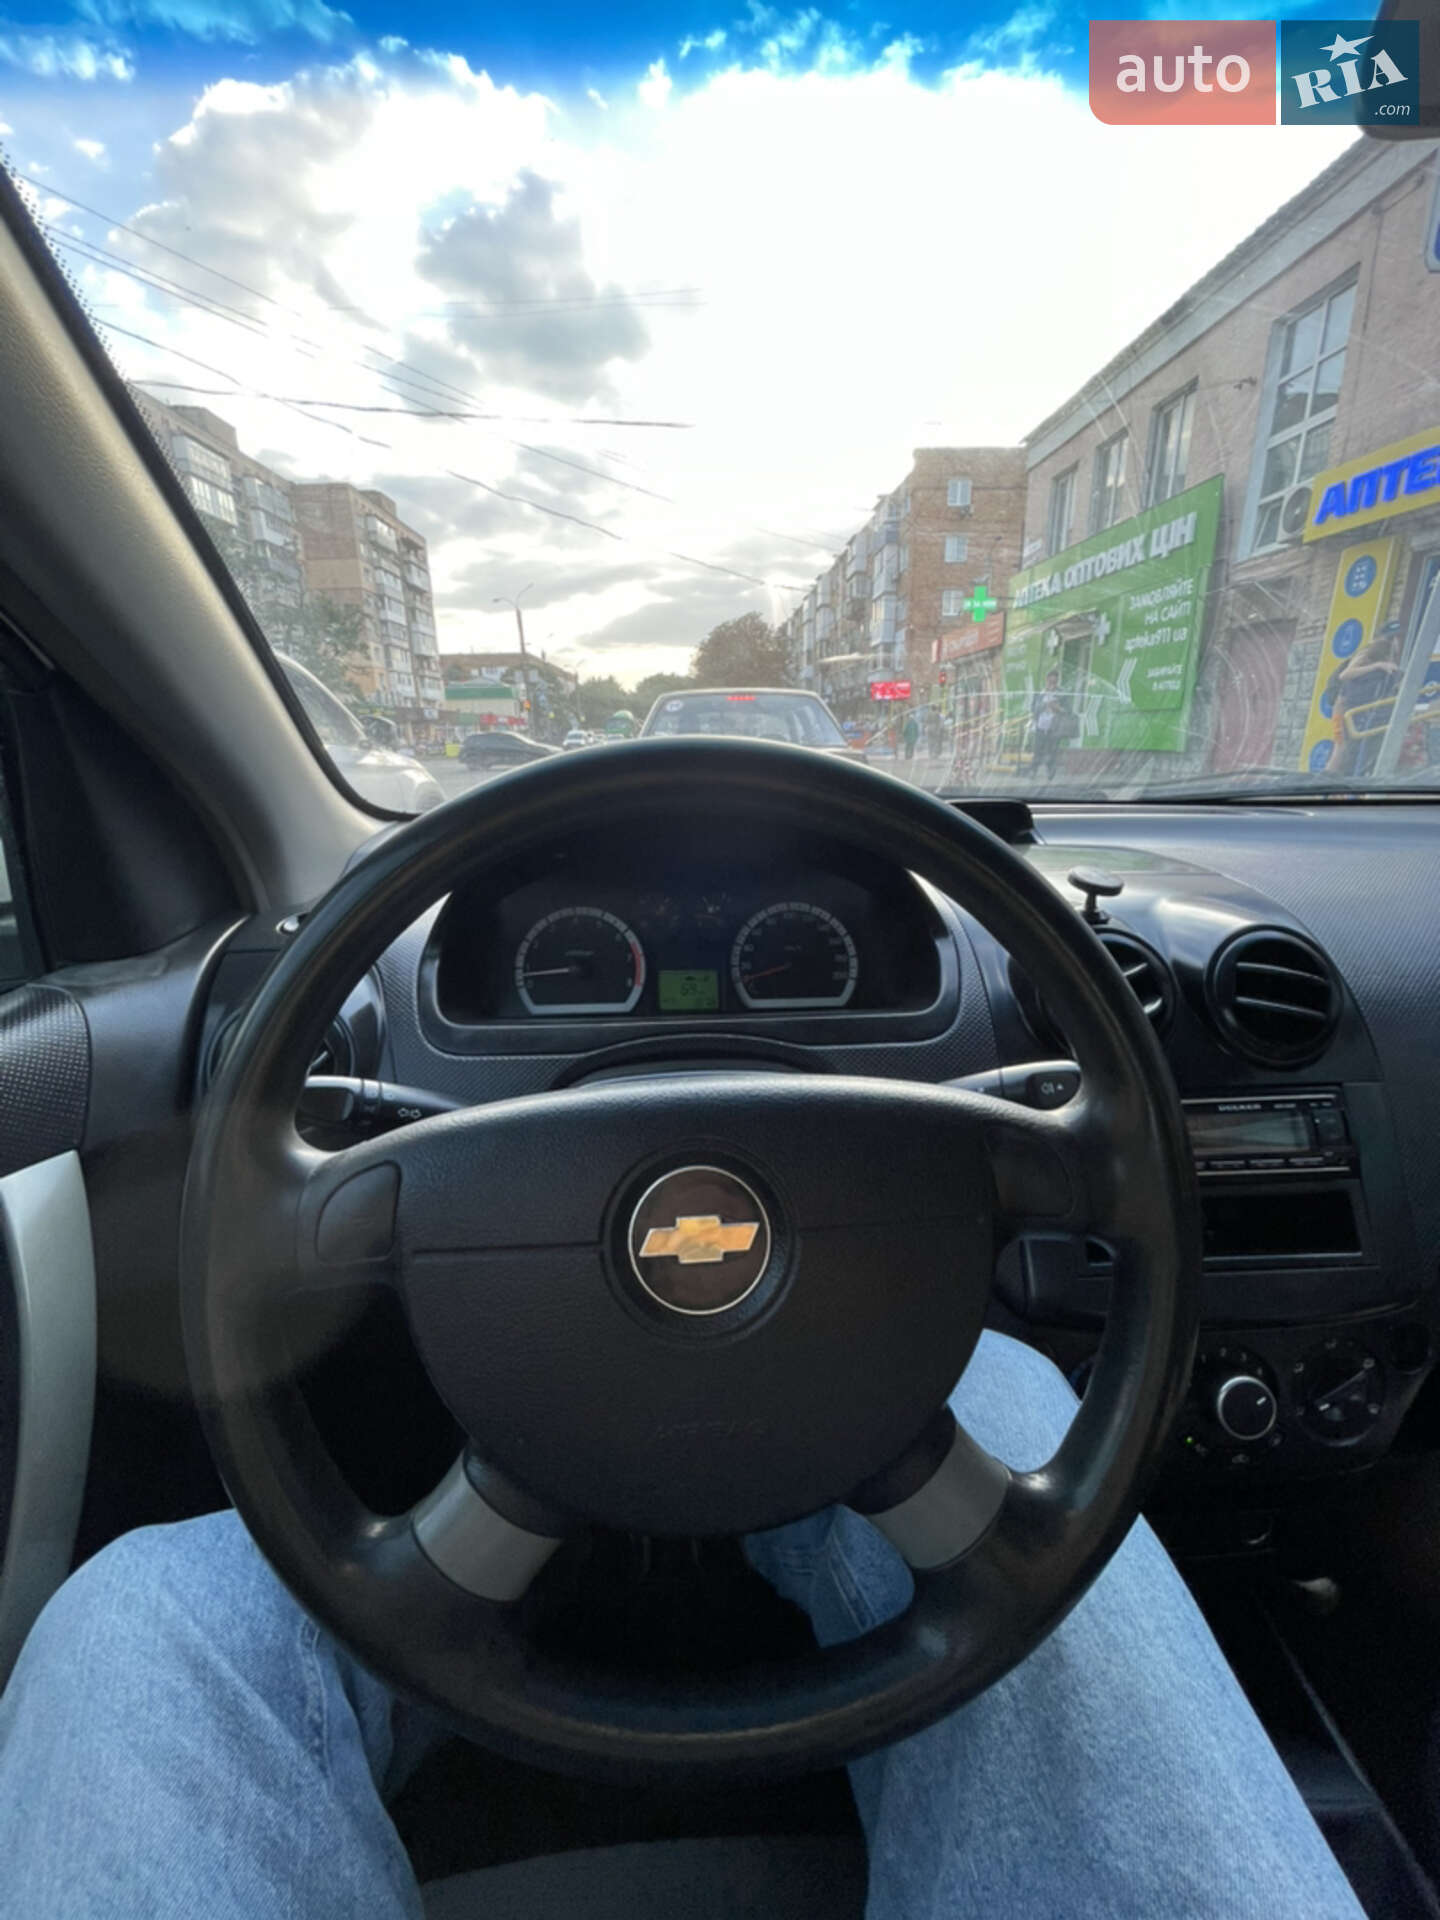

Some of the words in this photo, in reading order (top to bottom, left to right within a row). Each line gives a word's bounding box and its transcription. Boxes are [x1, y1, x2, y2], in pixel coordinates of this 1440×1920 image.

[1314, 445, 1440, 526] АПТЕ
[1013, 571, 1063, 609] АПТЕКА
[1064, 533, 1146, 588] ОПТОВИХ
